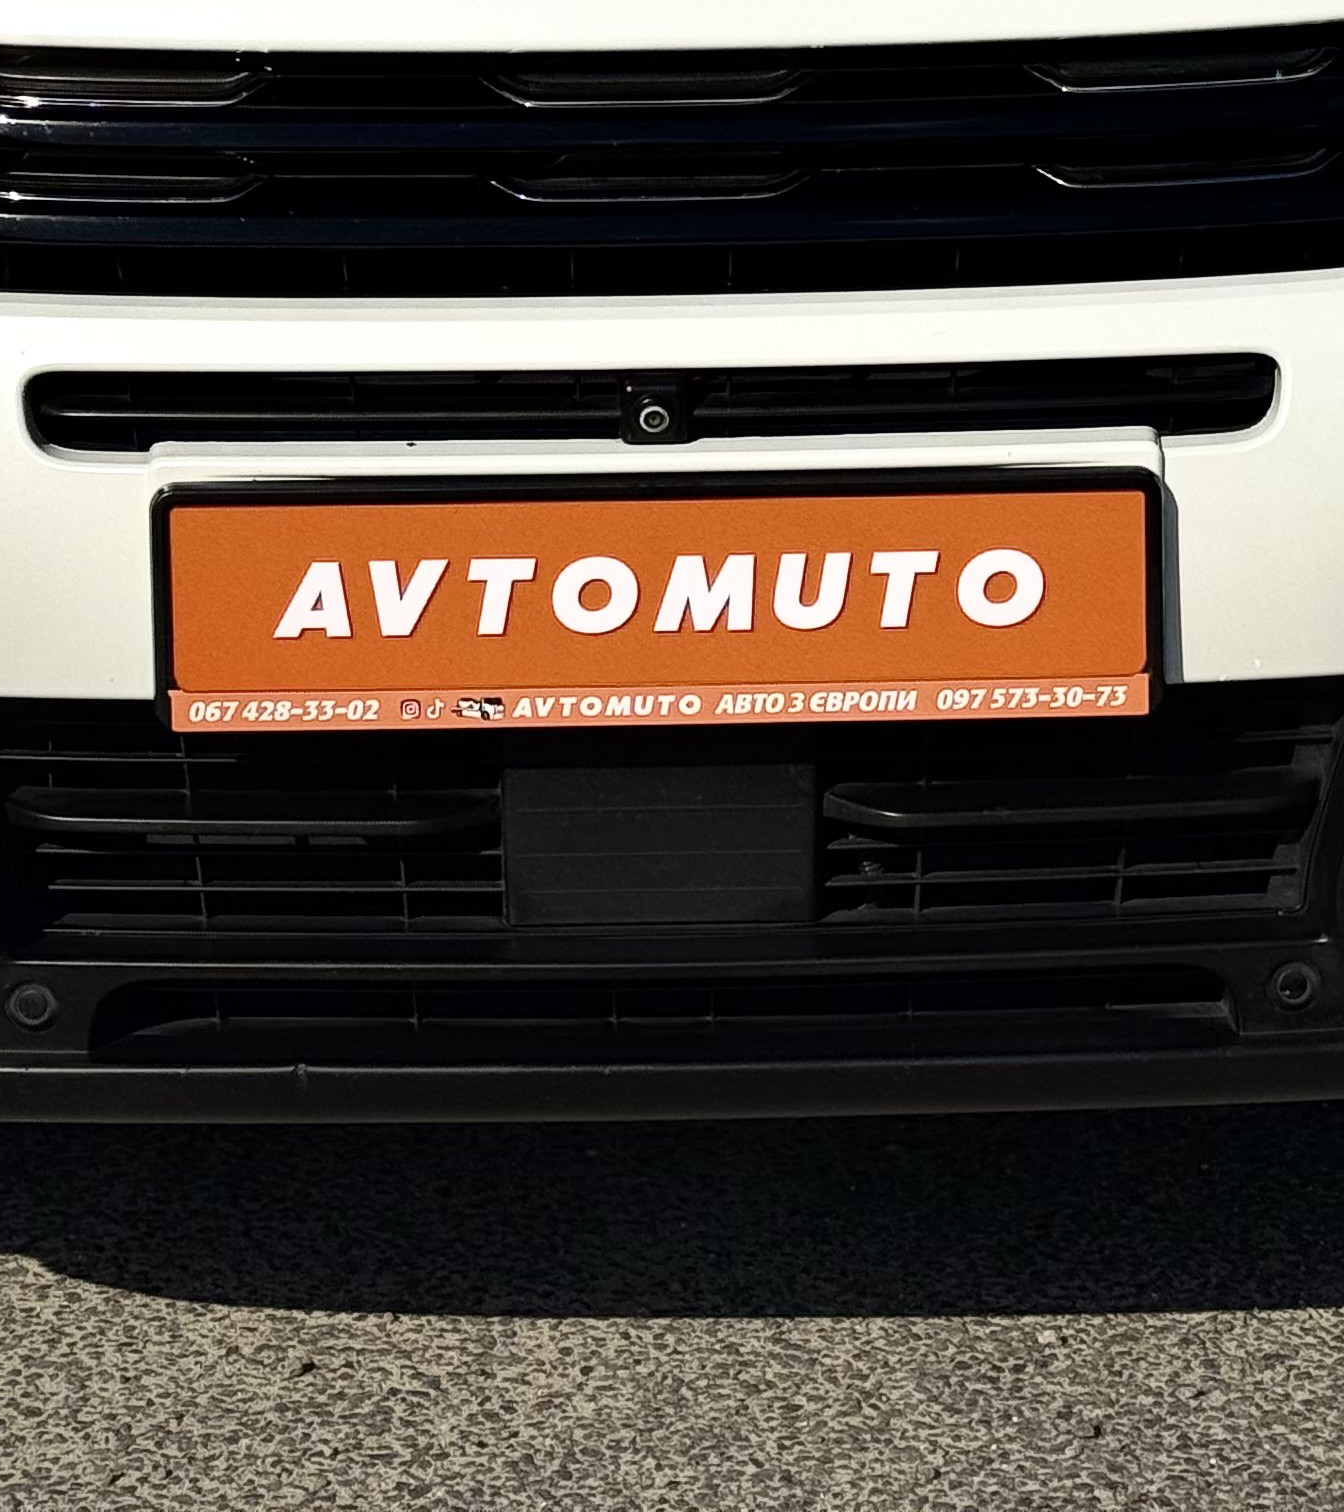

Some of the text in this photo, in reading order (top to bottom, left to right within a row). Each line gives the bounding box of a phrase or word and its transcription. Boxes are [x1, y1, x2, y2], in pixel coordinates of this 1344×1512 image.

[274, 548, 1046, 639] AVTOMUTO
[188, 700, 236, 722] 067
[241, 698, 381, 722] 428-33-02
[512, 694, 702, 719] AVTOMUTO
[715, 692, 783, 716] АВТО
[810, 688, 918, 714] ЄВРОПИ
[936, 687, 984, 711] 097
[990, 685, 1128, 710] 573-30-73
